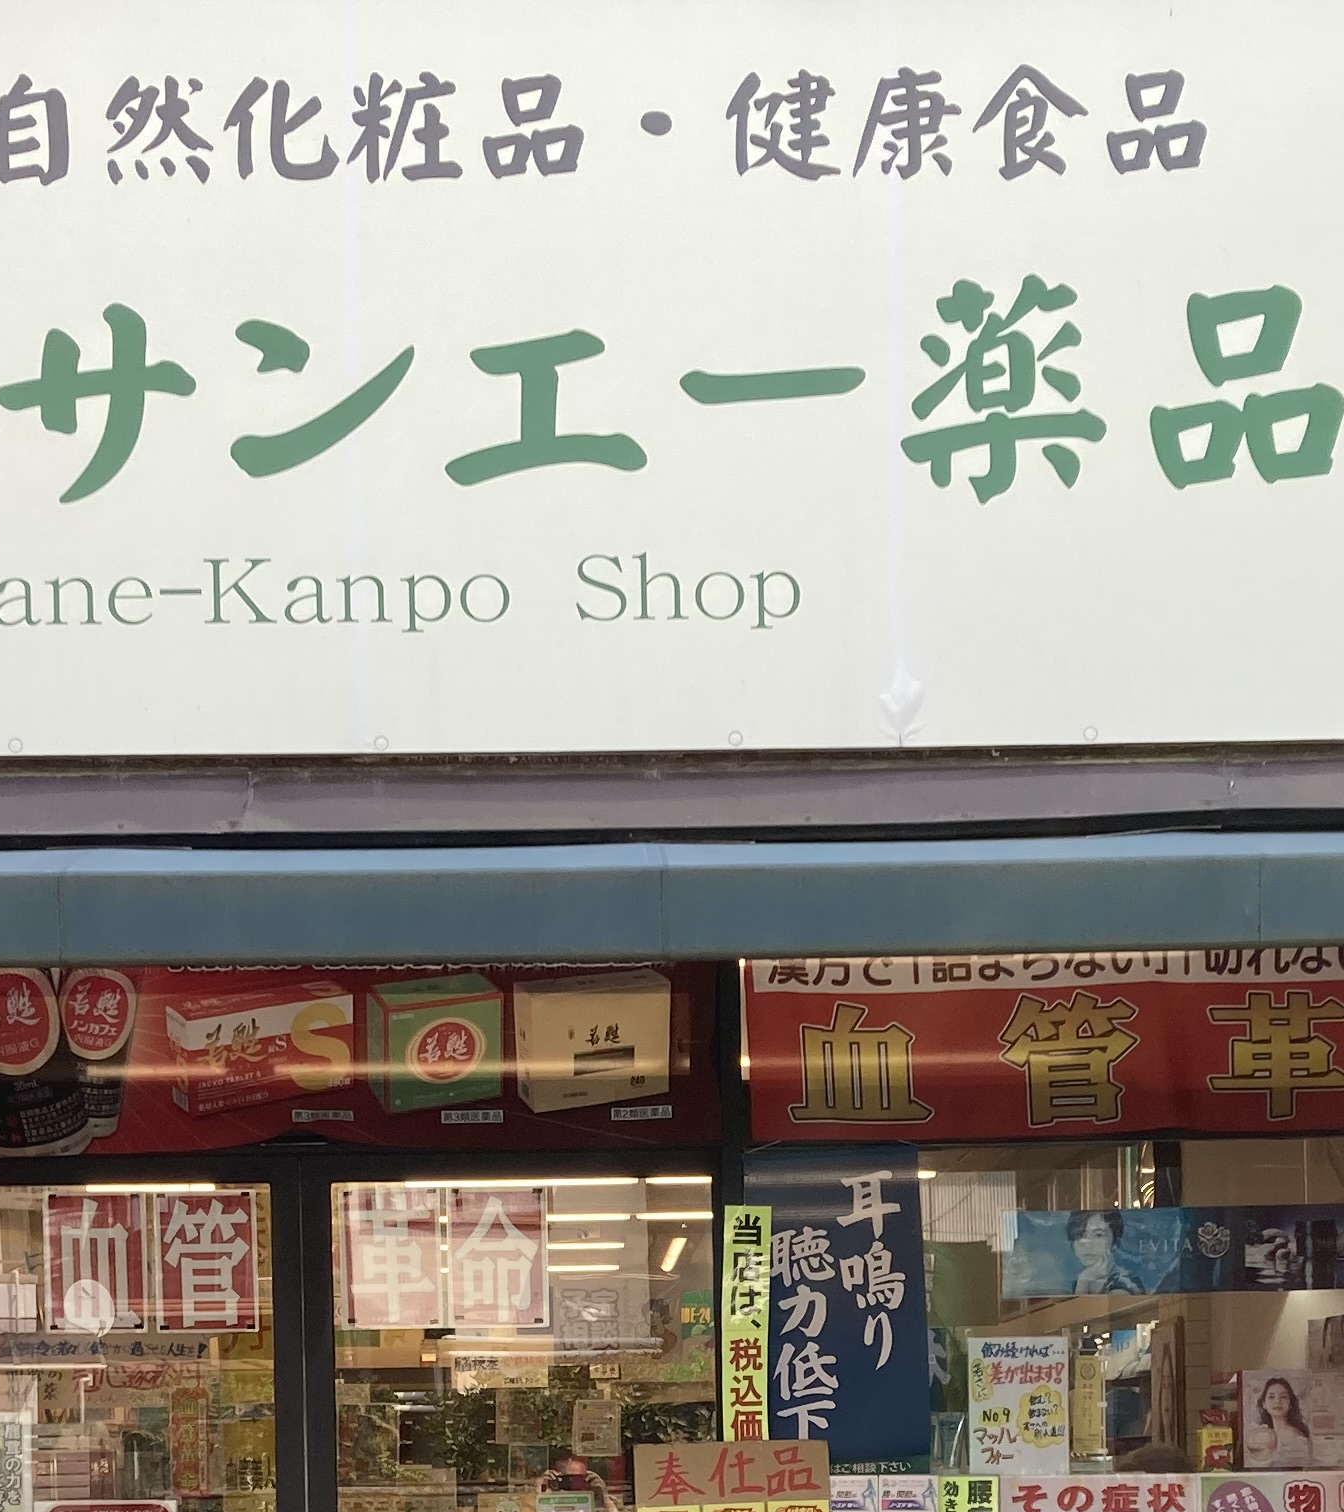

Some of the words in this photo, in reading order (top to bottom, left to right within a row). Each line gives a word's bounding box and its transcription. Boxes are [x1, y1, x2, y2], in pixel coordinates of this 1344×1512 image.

[574, 550, 804, 638] Shop
[836, 1170, 906, 1370] 耳鳴り
[1138, 1237, 1194, 1254] EVITA
[652, 1446, 822, 1505] 奉仕品
